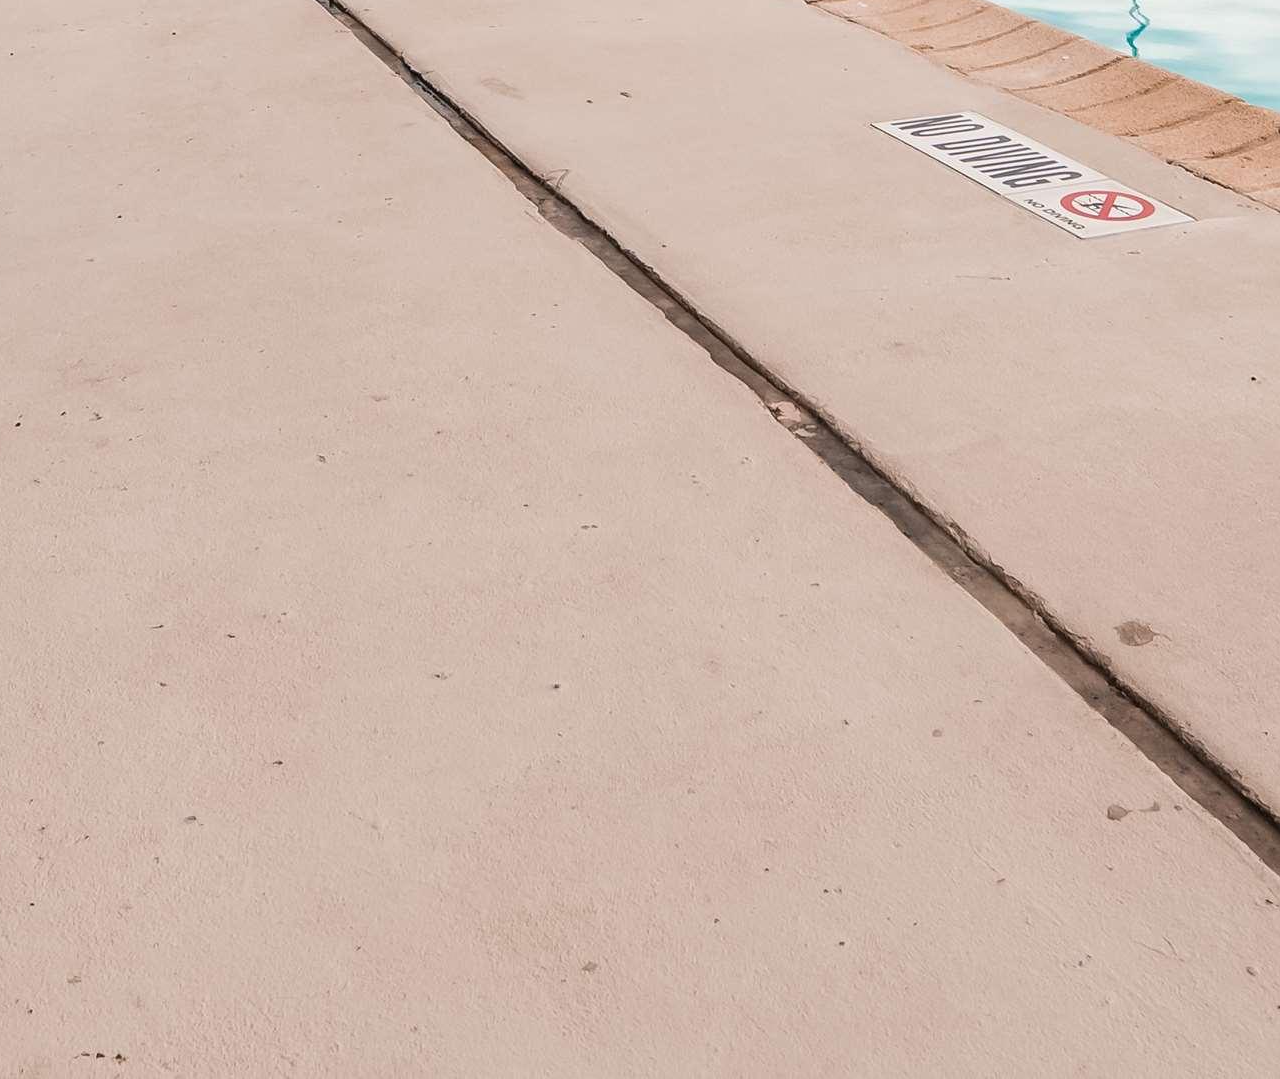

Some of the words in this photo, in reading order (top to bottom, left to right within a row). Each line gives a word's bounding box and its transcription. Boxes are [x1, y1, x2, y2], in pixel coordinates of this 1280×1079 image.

[890, 114, 985, 137] NO
[932, 134, 1082, 188] DIVING
[1024, 198, 1045, 209] NO
[1043, 207, 1085, 230] DIVING
